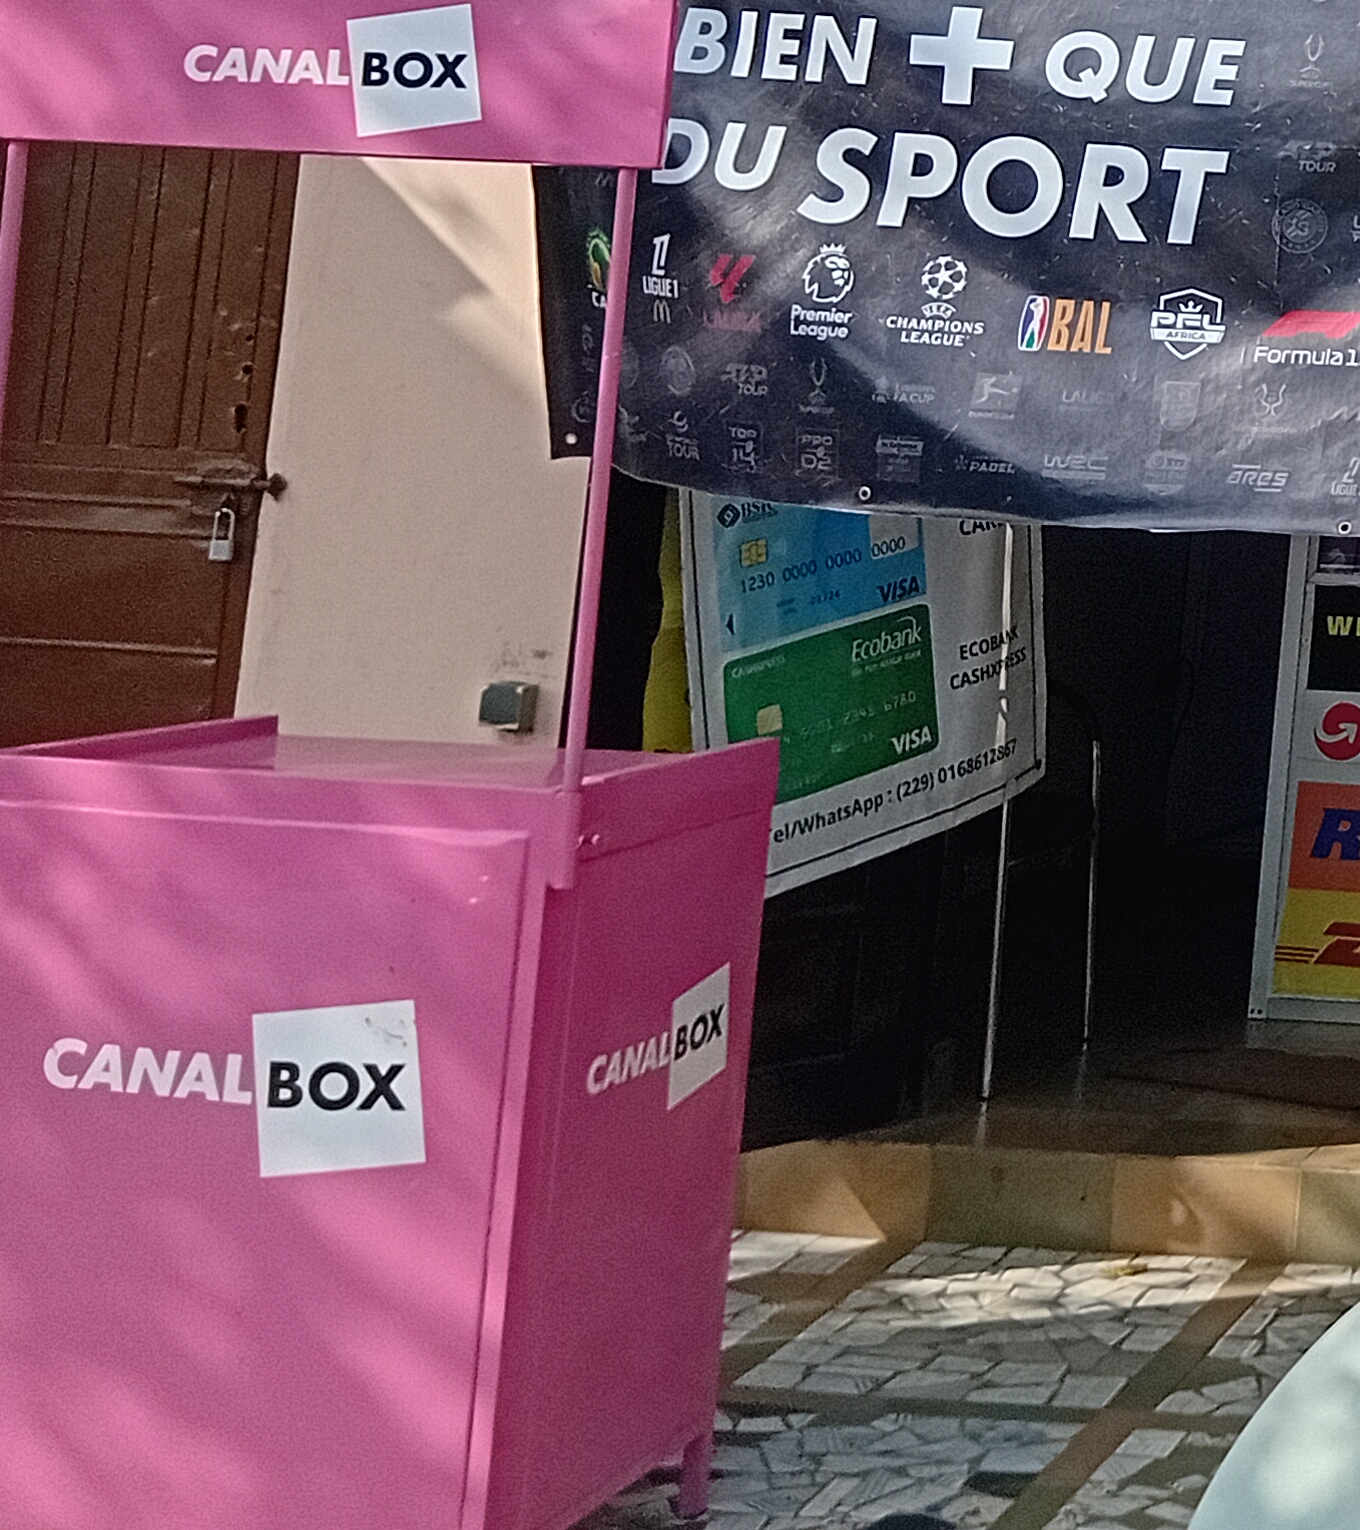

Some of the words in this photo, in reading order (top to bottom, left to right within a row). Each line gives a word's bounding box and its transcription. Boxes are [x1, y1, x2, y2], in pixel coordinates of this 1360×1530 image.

[672, 5, 879, 86] BIEN
[1044, 30, 1247, 107] QUE
[650, 117, 788, 192] DU
[796, 126, 1231, 246] SPORT
[789, 304, 853, 325] Premier
[789, 322, 850, 341] League
[885, 315, 986, 337] CHAMPIONS
[1046, 297, 1112, 355] BAL
[1150, 309, 1227, 332] PFL
[899, 331, 968, 348] LEAGUE
[1165, 329, 1208, 342] AFRICA
[876, 574, 921, 604] VISA
[850, 614, 922, 663] Ecobank
[958, 624, 1020, 661] ECOBANK
[949, 646, 1027, 691] CASHXPRESS
[889, 723, 933, 757] VISA
[769, 791, 885, 844] el/WhatsApp
[896, 767, 935, 803] (229)
[937, 738, 1018, 784] 0168612867
